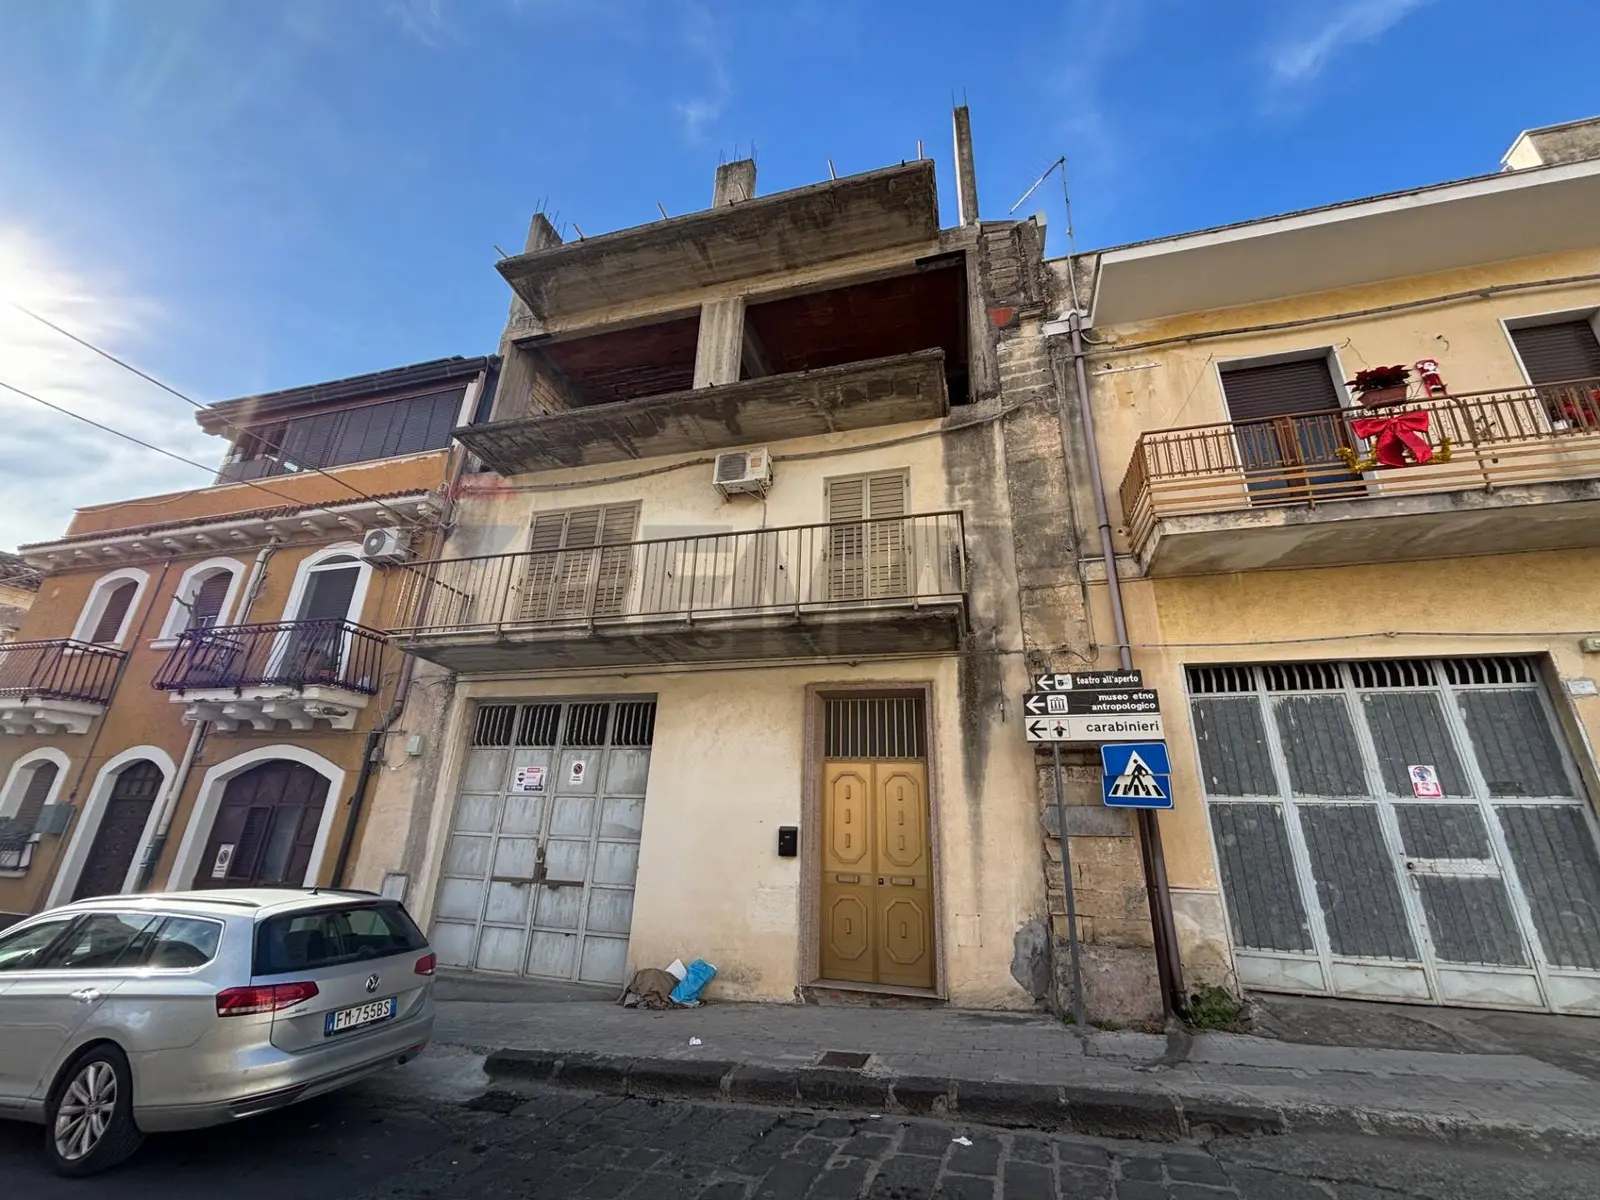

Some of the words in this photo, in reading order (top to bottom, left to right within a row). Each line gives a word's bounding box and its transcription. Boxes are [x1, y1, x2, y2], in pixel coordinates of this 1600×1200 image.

[1076, 676, 1100, 685] teatro
[1102, 674, 1139, 685] all'aperto
[1098, 693, 1128, 701] museo
[1132, 692, 1155, 700] etno
[1091, 703, 1156, 712] antropologico
[1086, 720, 1159, 732] carabinieri
